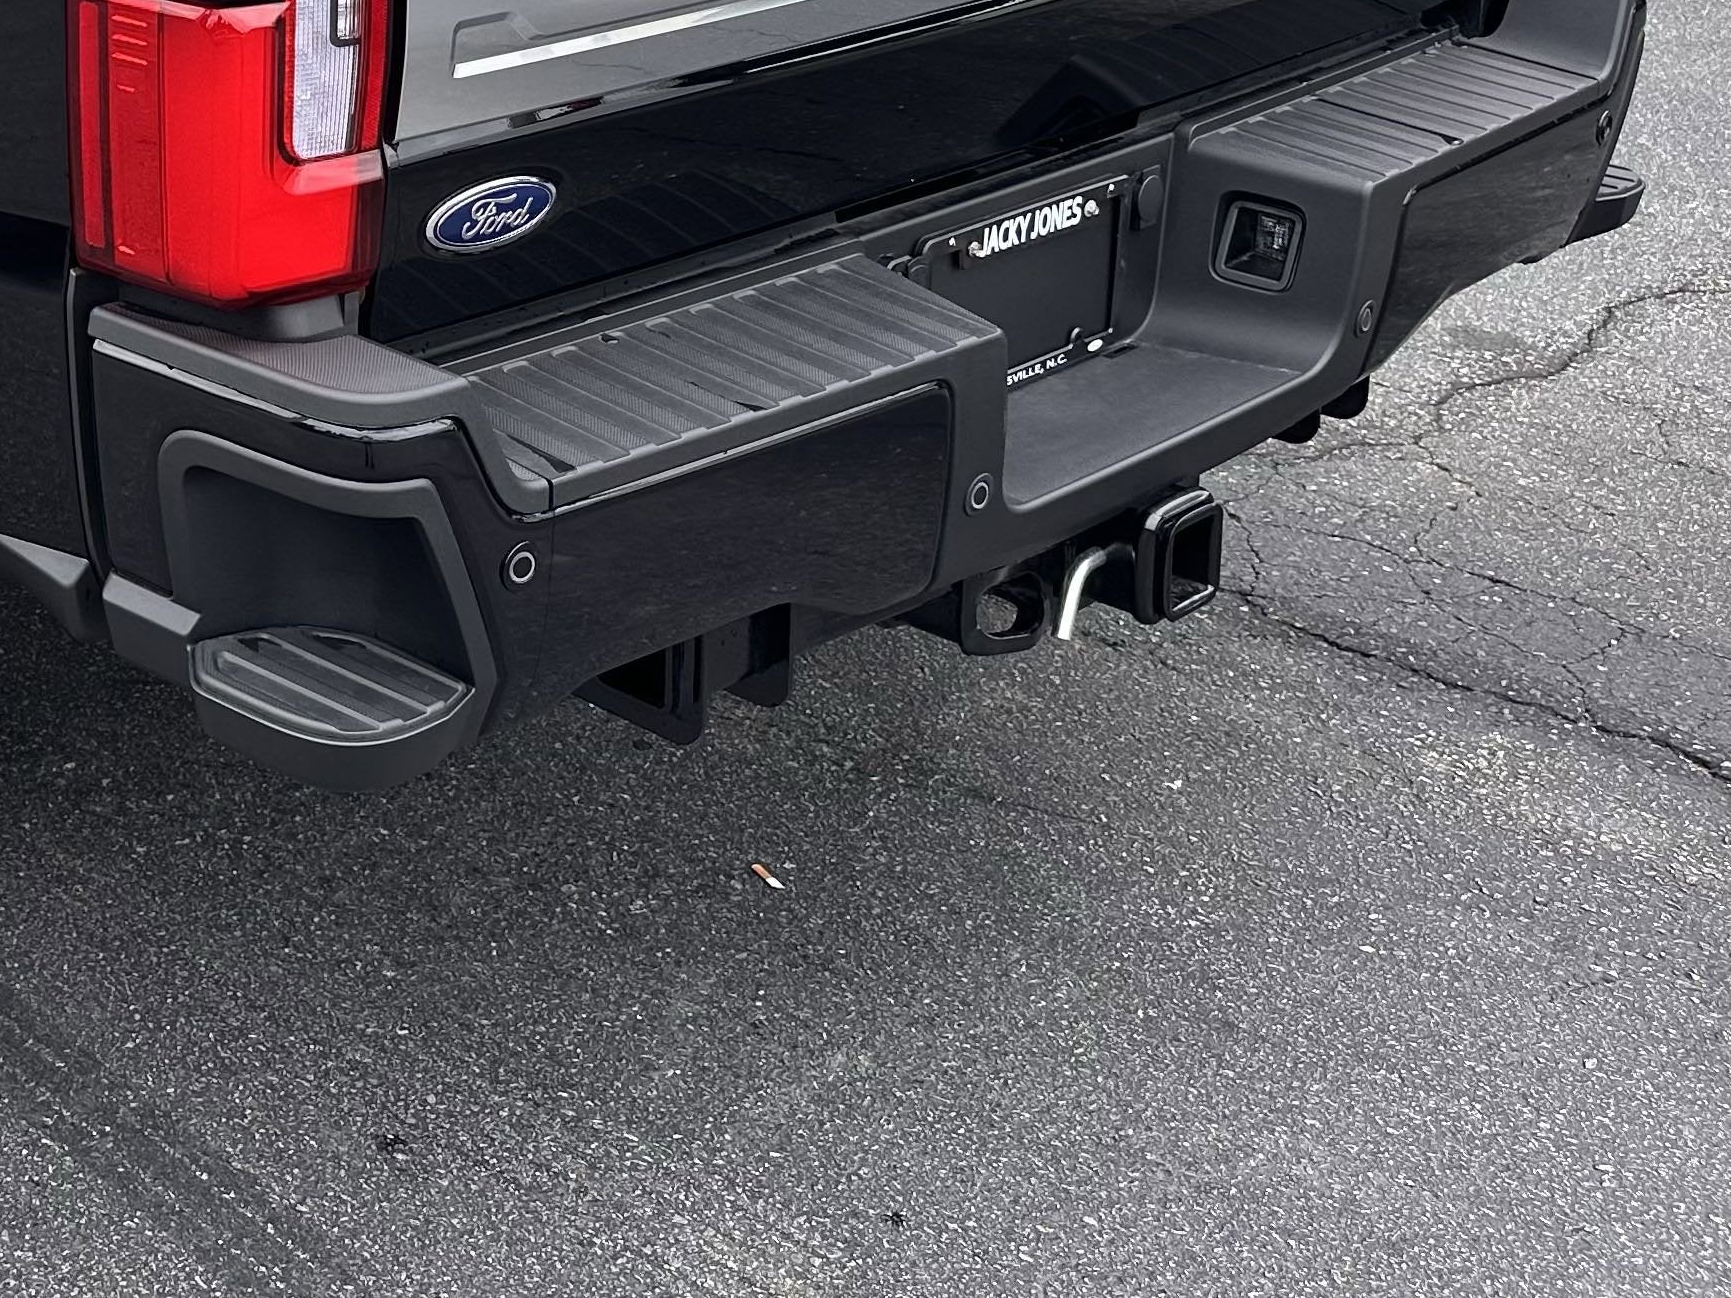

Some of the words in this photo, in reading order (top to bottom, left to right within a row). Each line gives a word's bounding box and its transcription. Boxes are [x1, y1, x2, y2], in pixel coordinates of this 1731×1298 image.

[974, 212, 1032, 258] JACKY
[1030, 195, 1083, 241] JONES
[1006, 363, 1045, 386] SVILLE,
